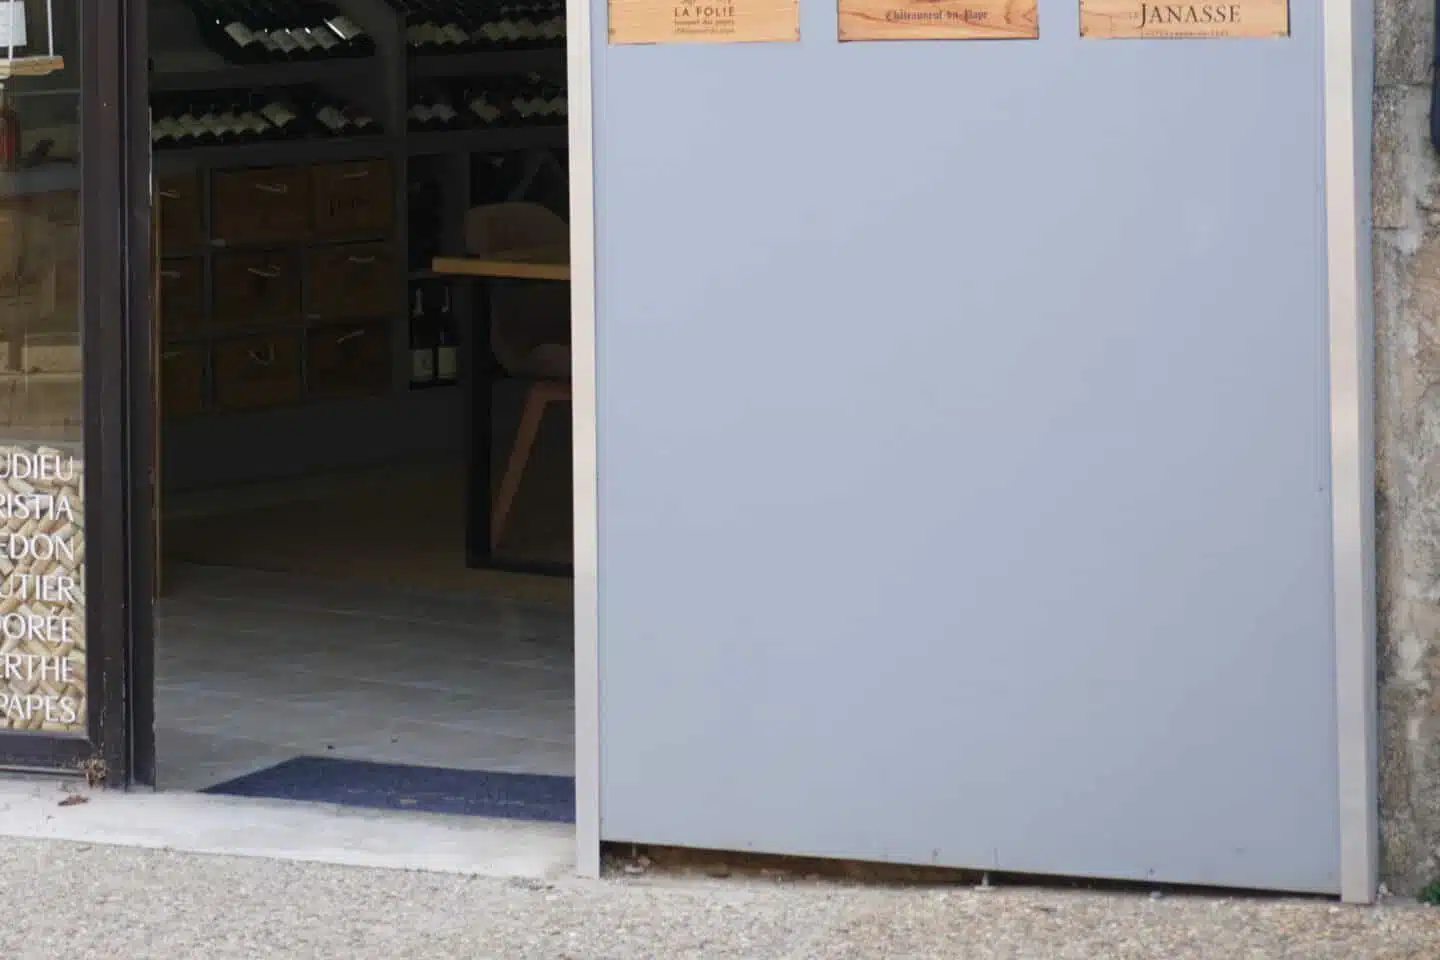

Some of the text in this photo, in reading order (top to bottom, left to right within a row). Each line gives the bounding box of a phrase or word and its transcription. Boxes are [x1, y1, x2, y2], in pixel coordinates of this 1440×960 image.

[674, 6, 735, 16] LA FOLIE
[1137, 3, 1241, 28] JANASSE
